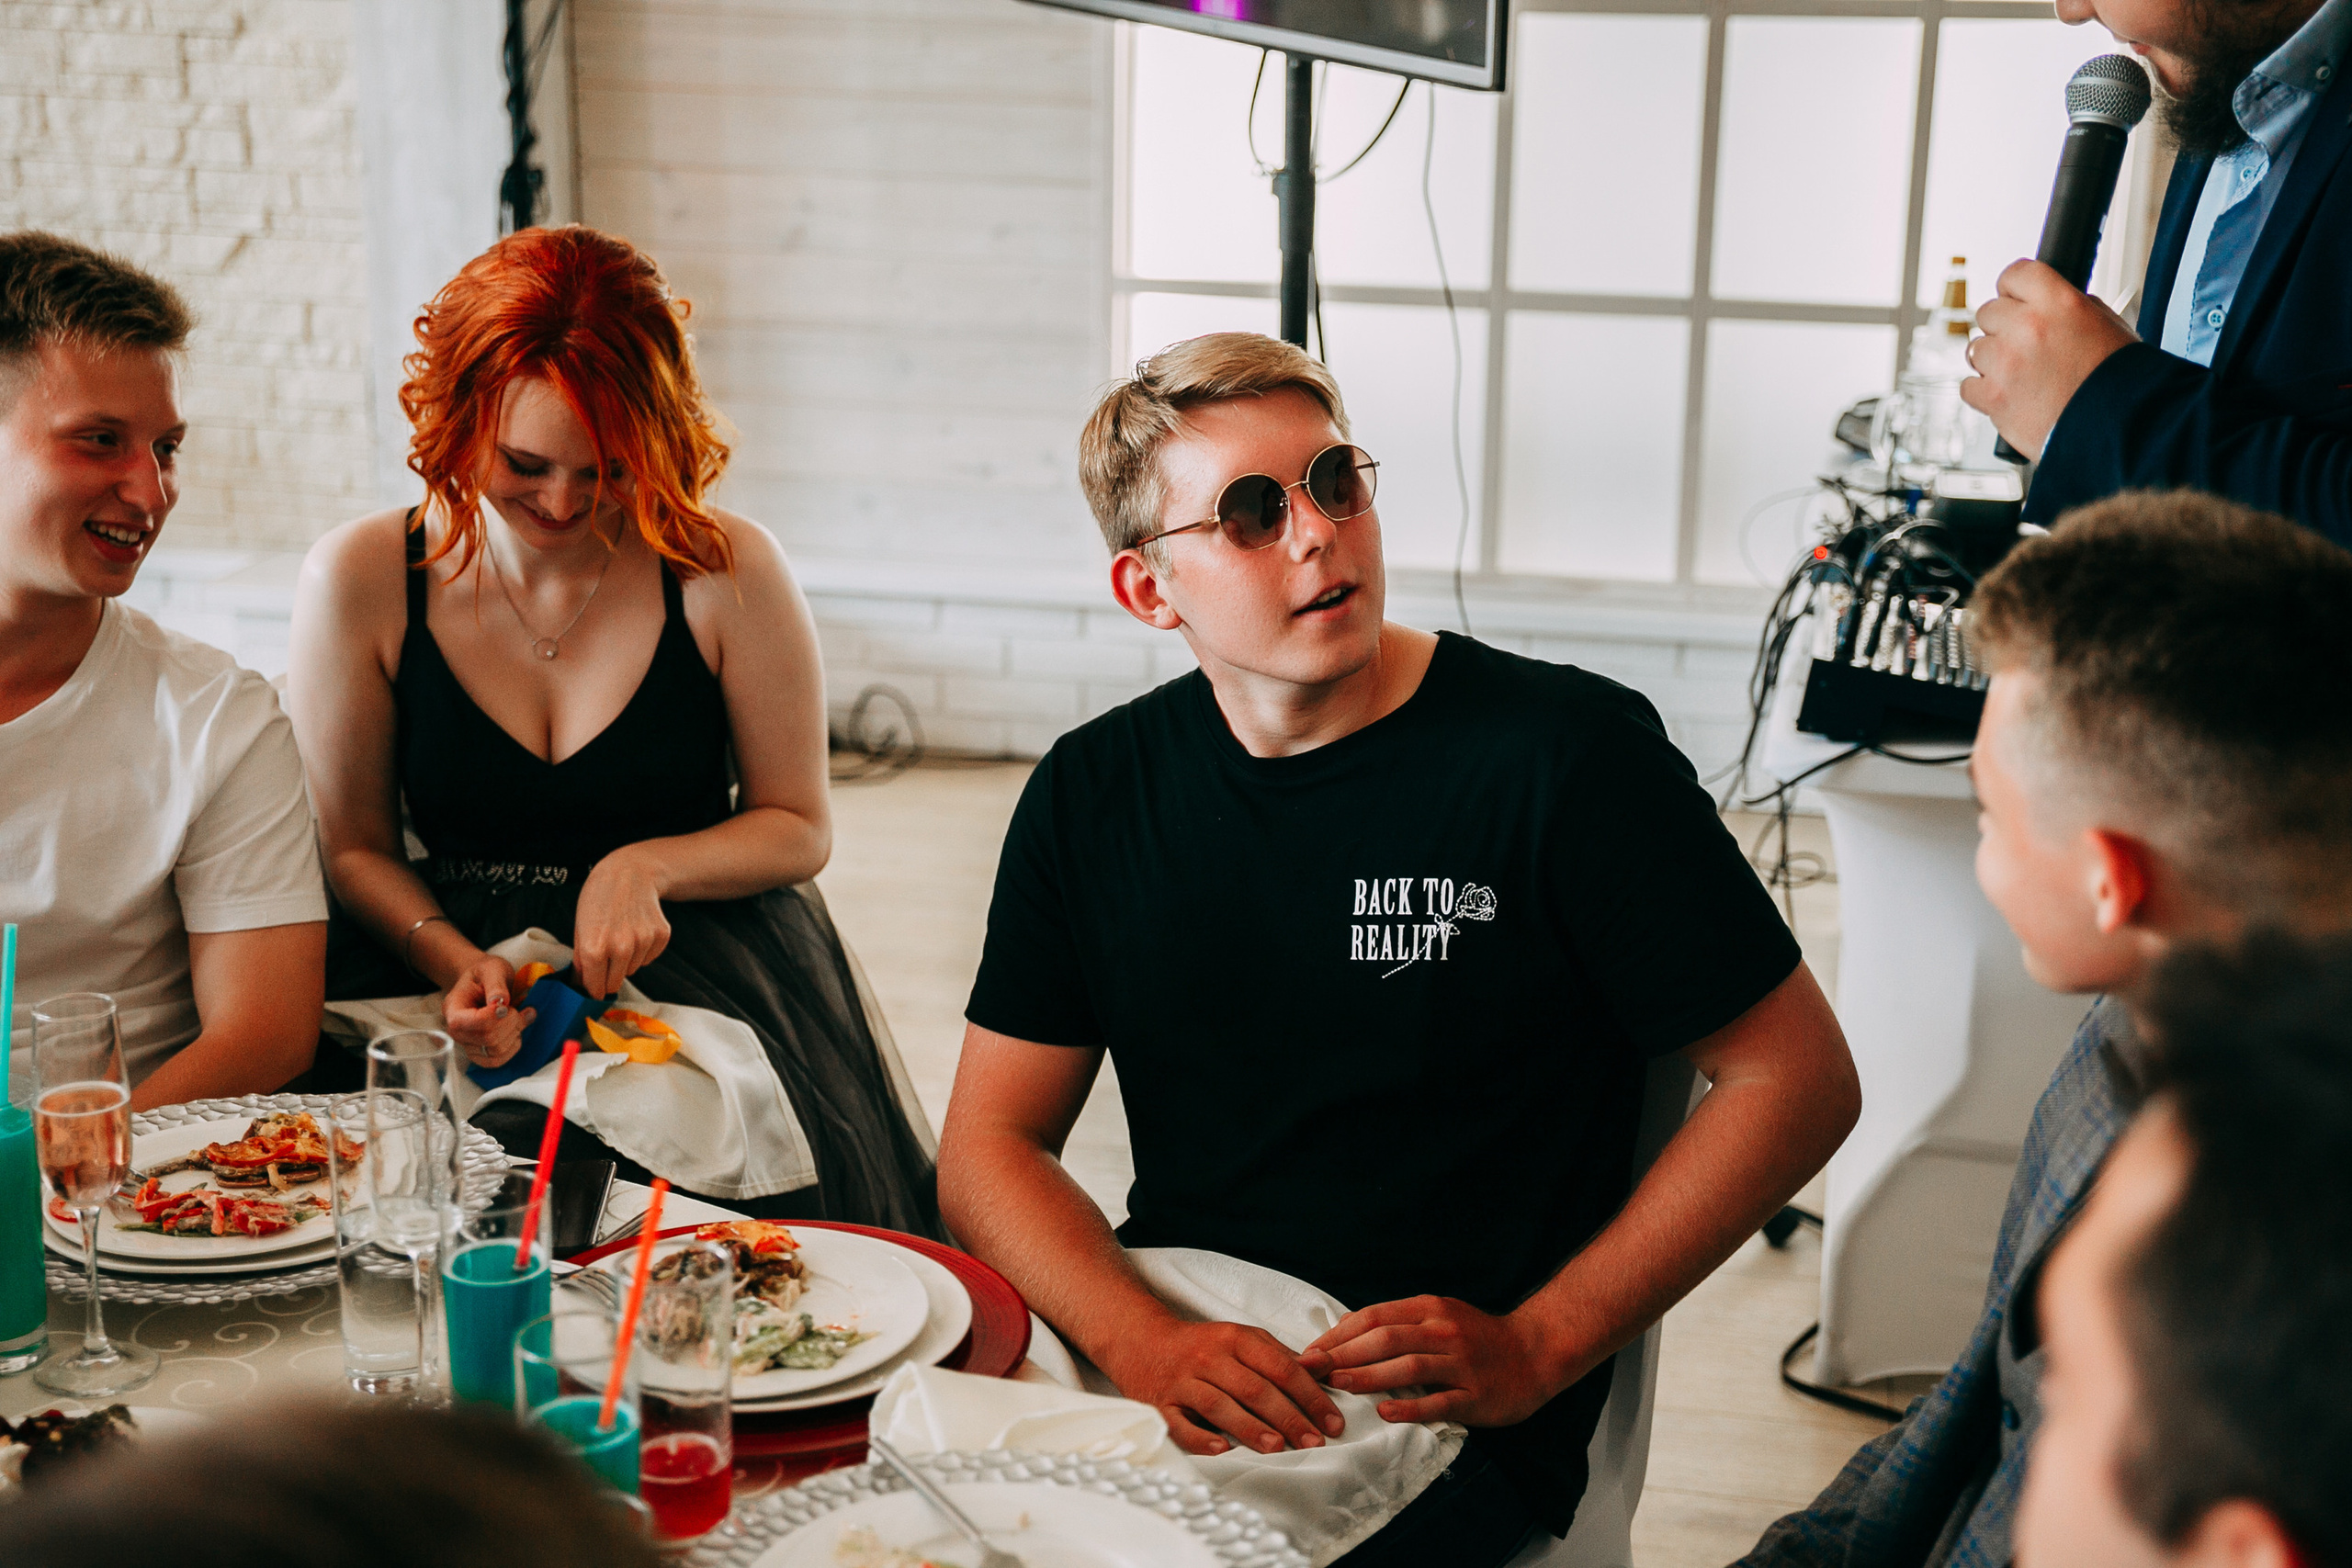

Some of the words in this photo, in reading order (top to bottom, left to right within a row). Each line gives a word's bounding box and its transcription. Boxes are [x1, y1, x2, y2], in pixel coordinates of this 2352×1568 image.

[1352, 878, 1414, 915] BACK
[1423, 878, 1454, 915] TO
[1350, 924, 1451, 961] REALITY
